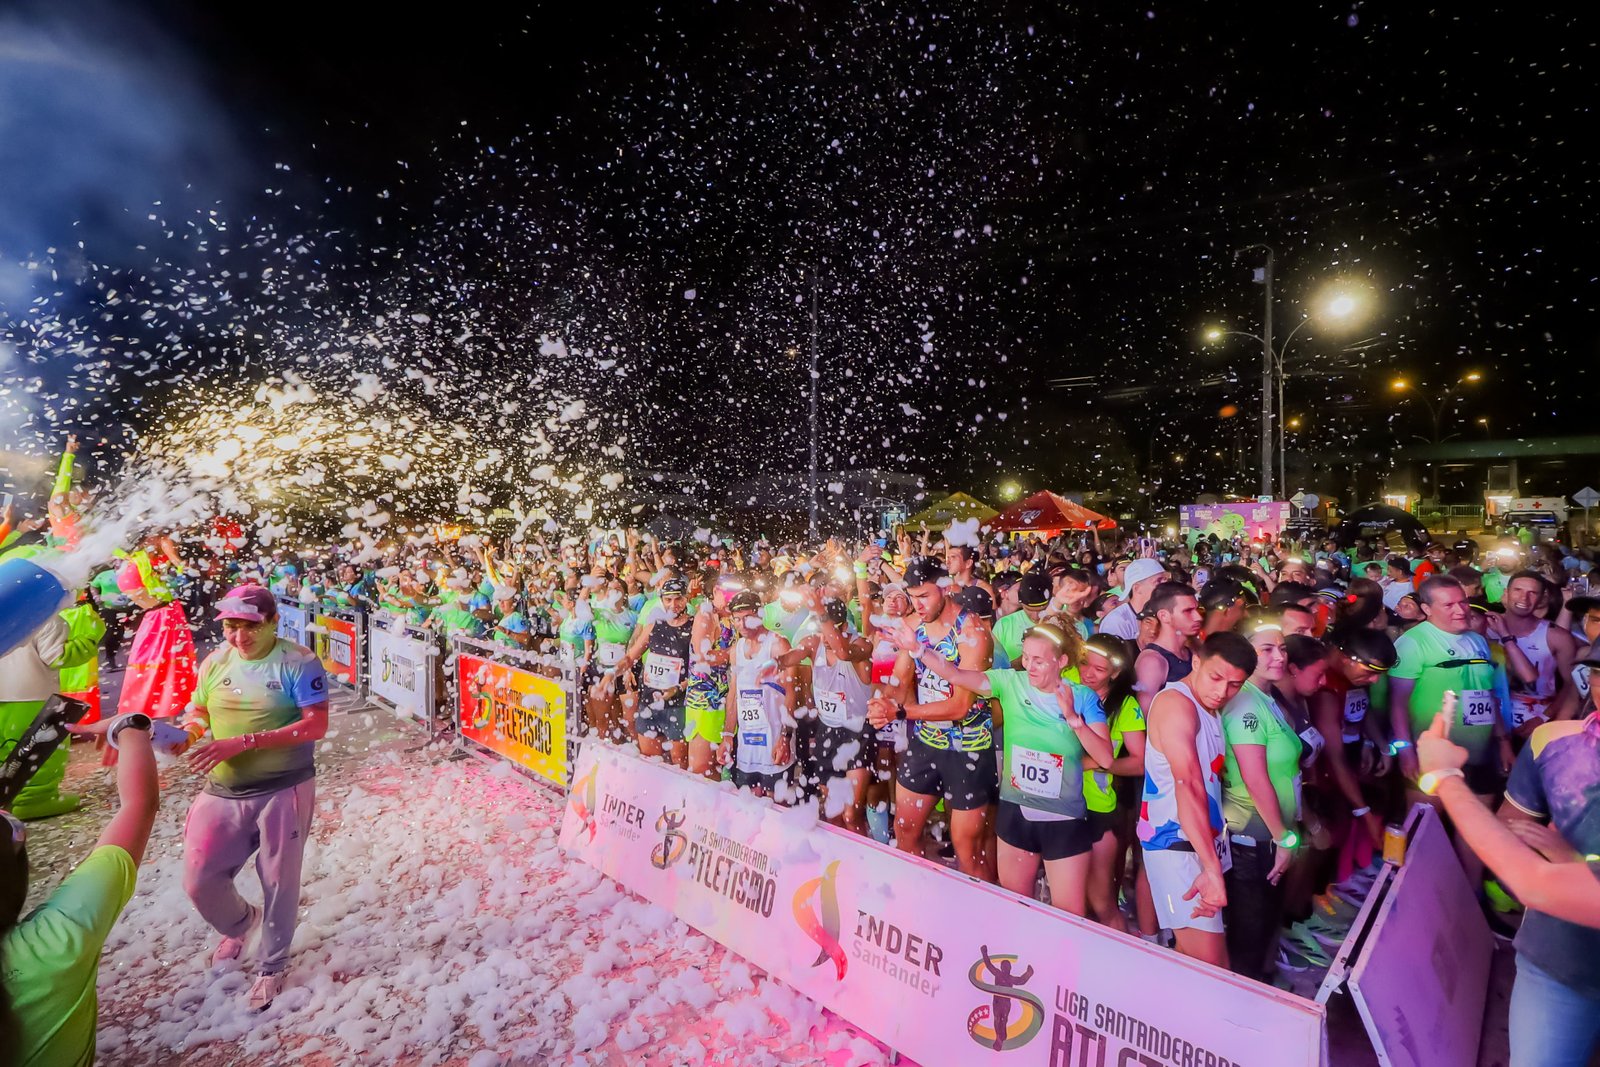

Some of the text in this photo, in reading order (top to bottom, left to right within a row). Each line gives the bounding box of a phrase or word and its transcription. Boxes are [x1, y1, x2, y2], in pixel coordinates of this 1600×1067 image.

[742, 709, 760, 721] 293
[819, 699, 837, 713] 137
[1349, 698, 1367, 715] 285
[1469, 702, 1493, 716] 284
[1020, 763, 1050, 784] 103
[687, 841, 777, 918] ATLETISMO
[853, 909, 944, 977] INDER
[851, 939, 941, 998] Santander
[1055, 984, 1089, 1023] LIGA
